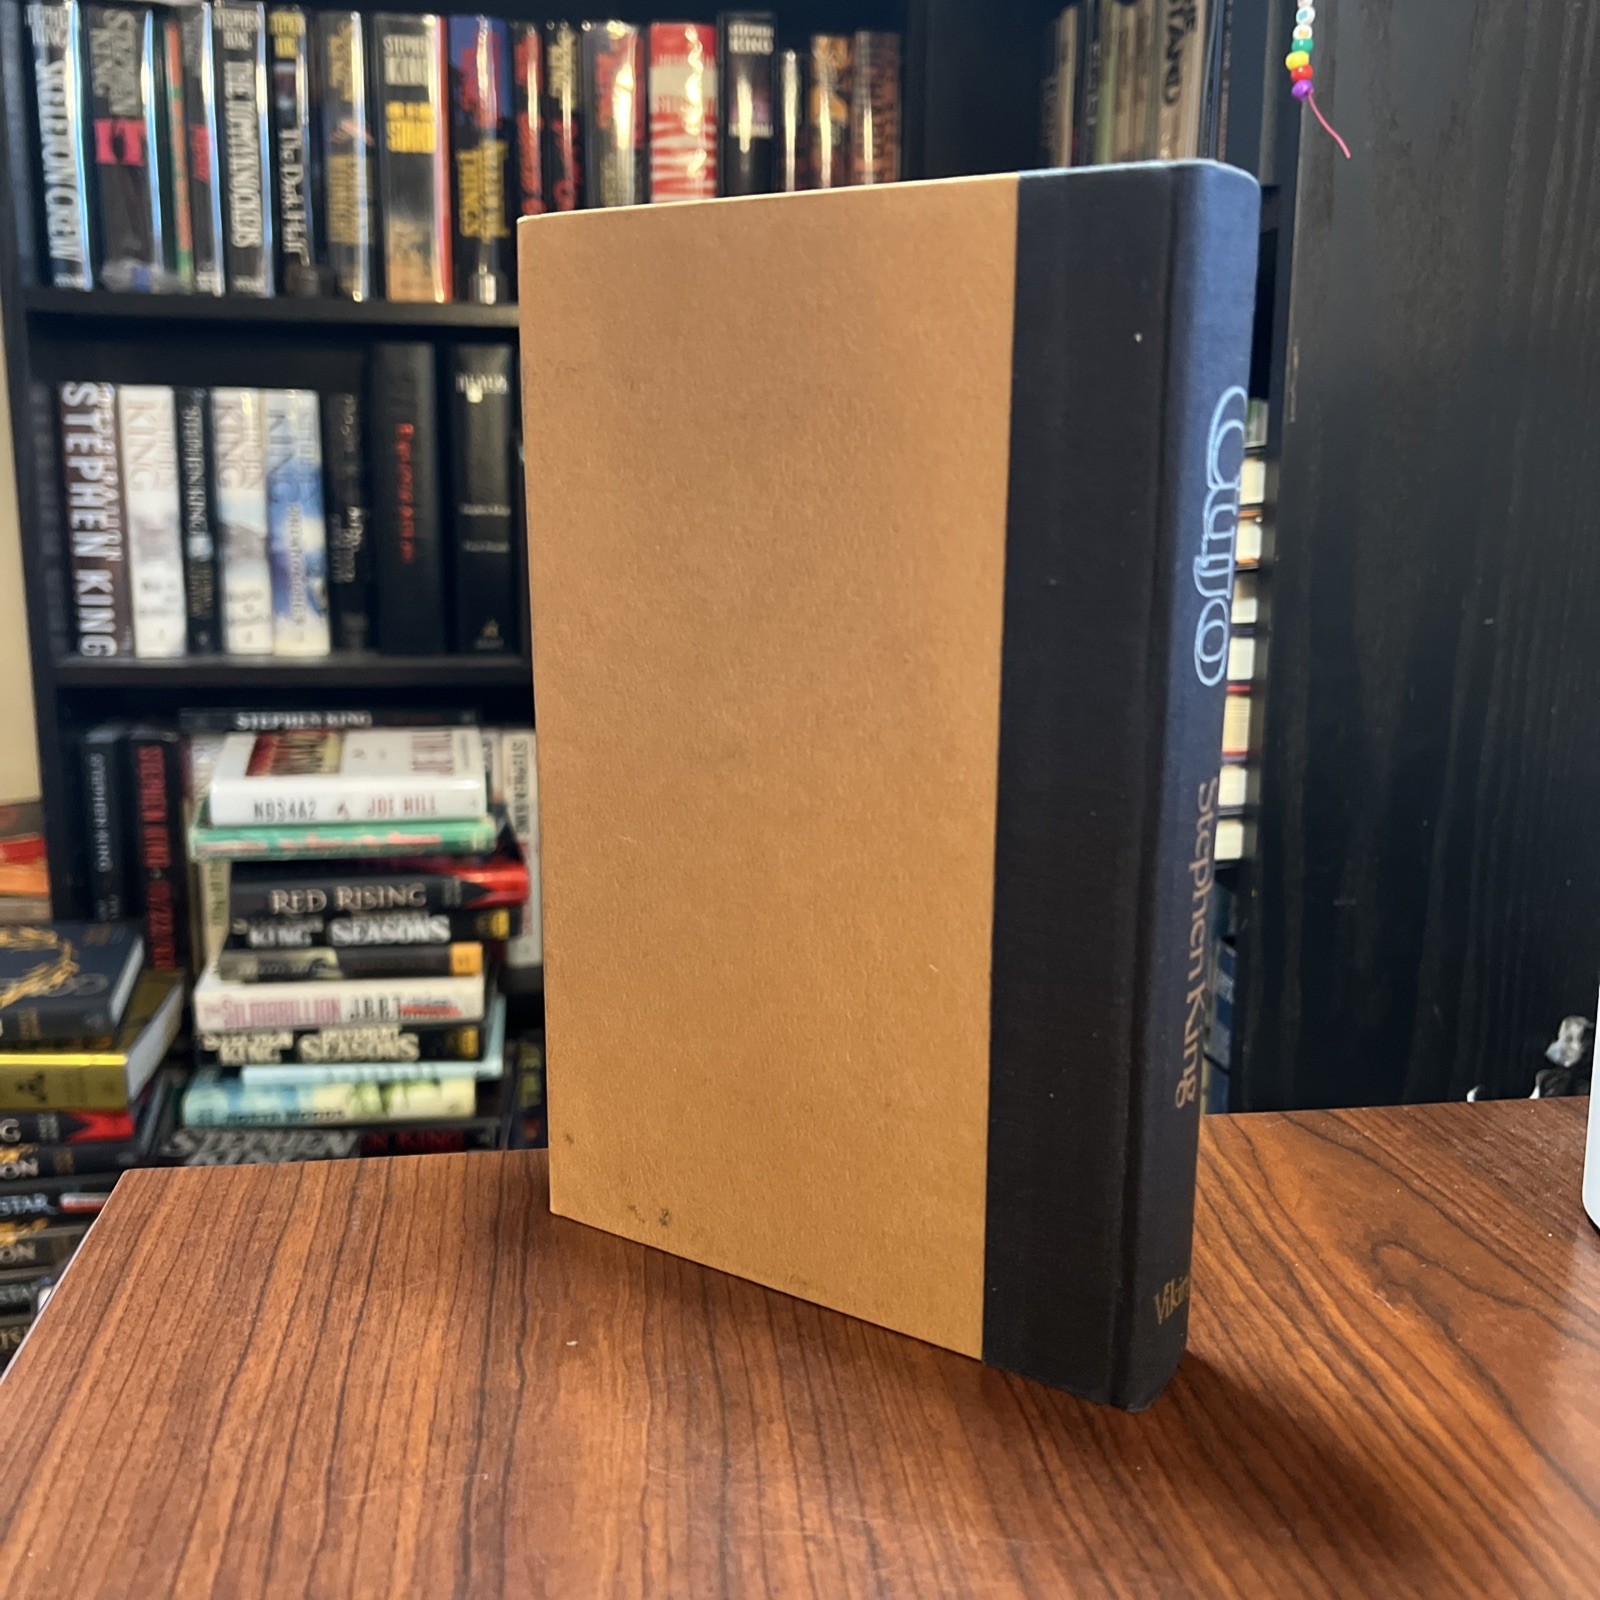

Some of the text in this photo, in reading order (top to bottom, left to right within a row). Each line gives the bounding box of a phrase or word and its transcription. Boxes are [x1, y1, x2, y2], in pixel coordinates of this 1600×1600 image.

[35, 60, 78, 187] SKELETON
[94, 117, 146, 167] IT
[45, 186, 84, 262] CREW
[125, 400, 159, 491] KING
[215, 401, 246, 489] KING
[62, 381, 118, 658] STEPHEN KING
[1193, 385, 1248, 687] Cujo
[234, 711, 322, 731] STEPHEN
[252, 795, 437, 822] NOS4A2 JOE HILL
[268, 882, 427, 914] RED RISING
[326, 915, 452, 947] SEASONS
[1173, 777, 1218, 1110] Stephen King
[298, 1032, 421, 1063] SEASONS
[0, 1158, 39, 1179] ON
